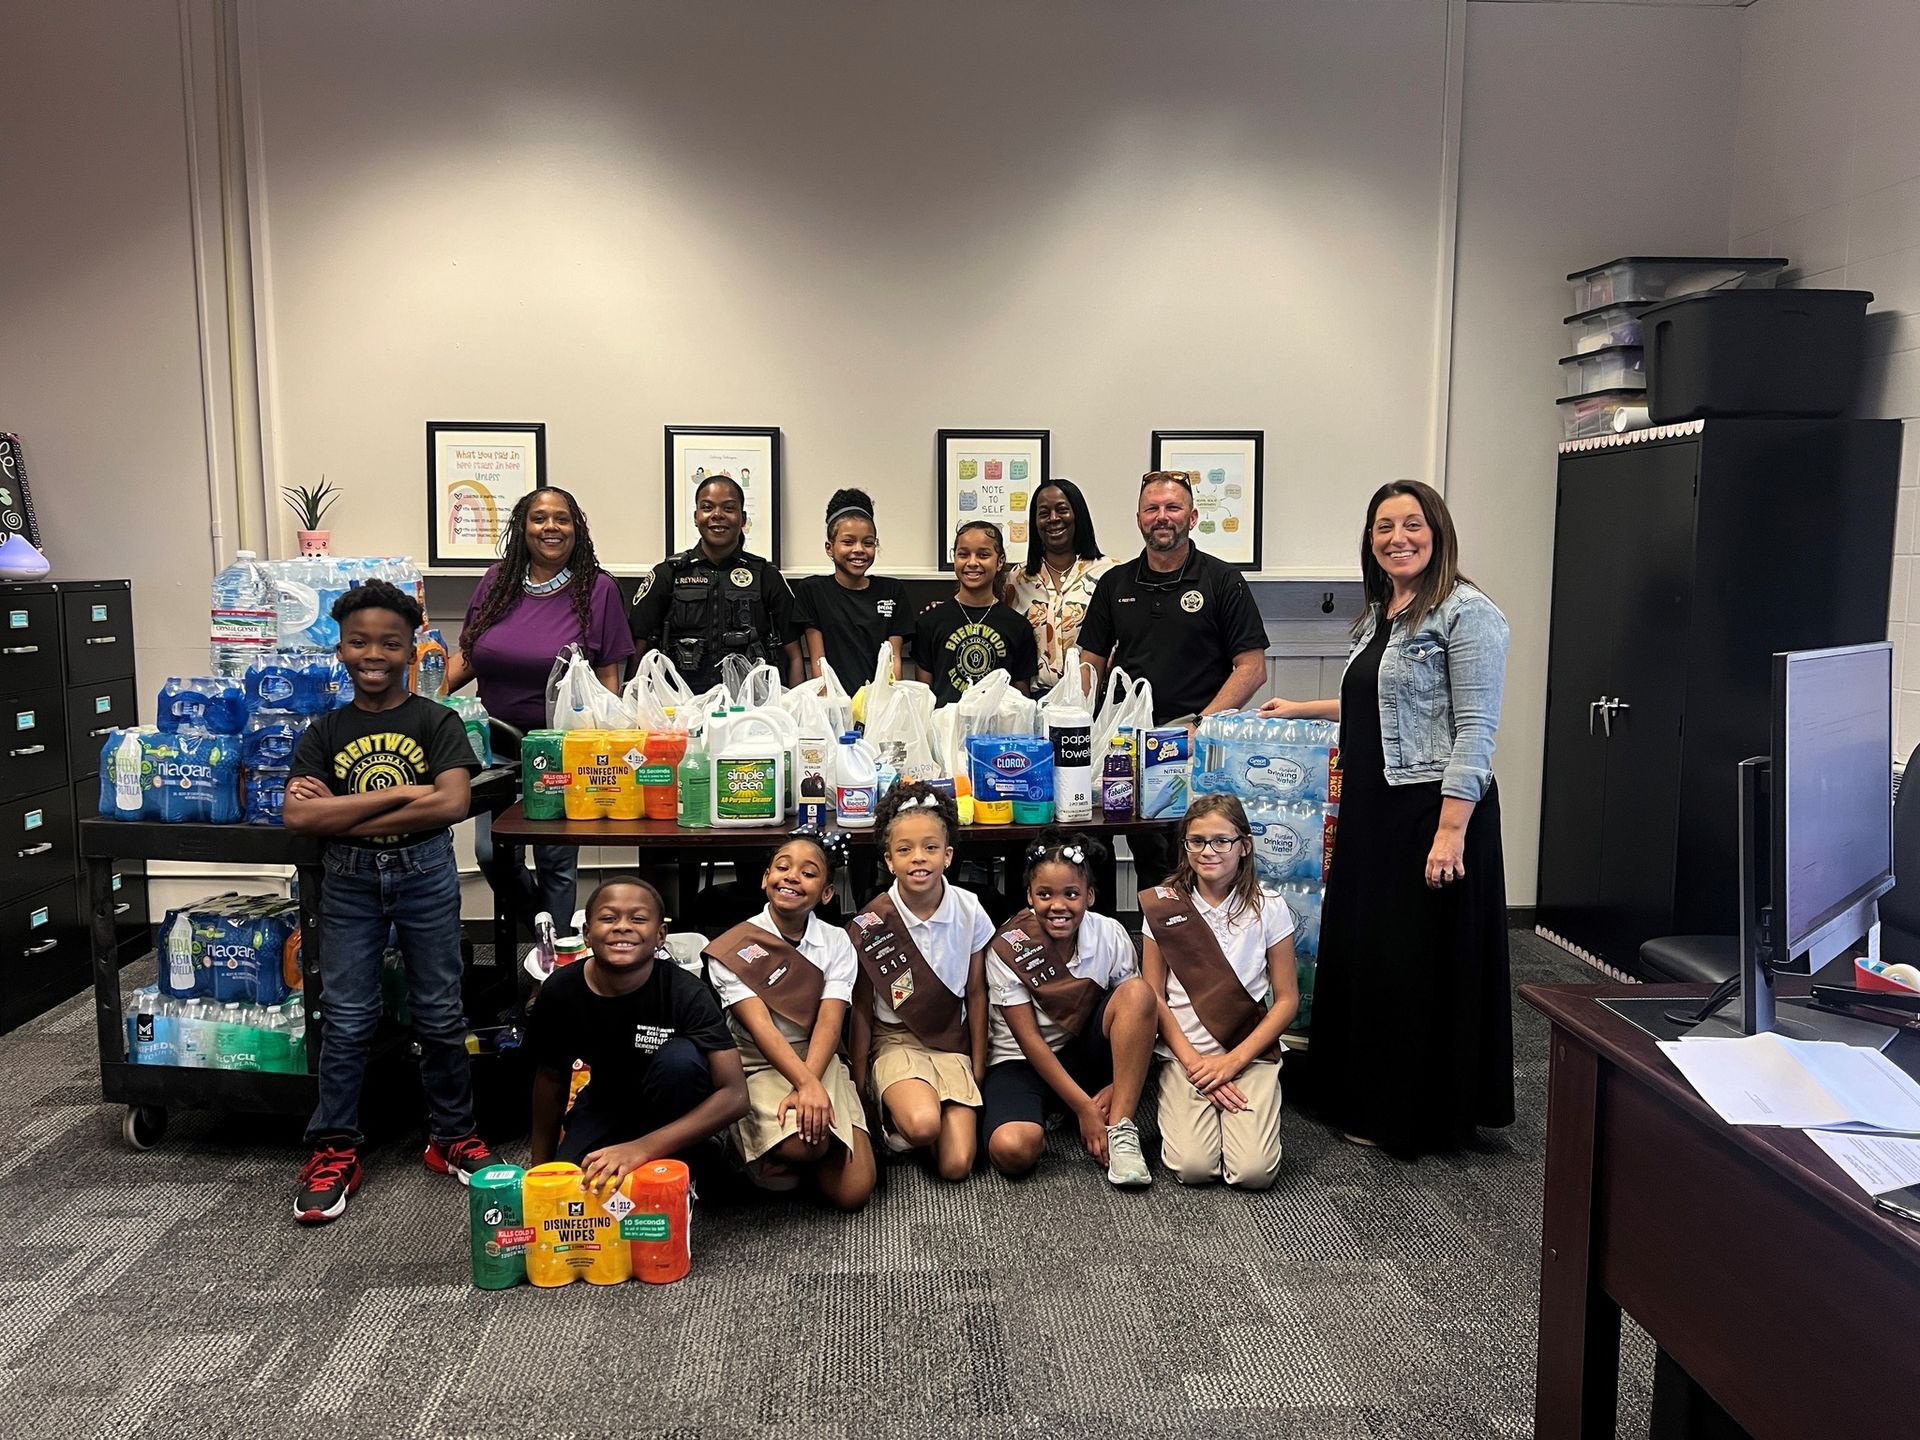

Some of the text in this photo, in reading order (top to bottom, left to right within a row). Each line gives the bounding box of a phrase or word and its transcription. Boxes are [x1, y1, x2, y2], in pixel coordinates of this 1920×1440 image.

[456, 450, 476, 460] What
[478, 451, 492, 460] you
[982, 486, 1004, 494] NOTE
[988, 496, 998, 504] TO
[982, 505, 1005, 514] SELF
[944, 623, 1006, 658] BRENTWOOD
[1062, 735, 1090, 746] pape
[1158, 741, 1178, 761] Soft Scrub
[354, 754, 407, 774] NATIONAL
[996, 758, 1026, 768] CLOROX
[158, 762, 212, 779] niagara
[578, 766, 628, 776] DISINFECTING
[727, 769, 764, 782] simple
[1268, 769, 1298, 780] Drinking
[589, 776, 617, 785] WIPES
[728, 782, 764, 793] green
[1108, 784, 1133, 798] Fabuloso
[1264, 838, 1293, 847] Drinking
[1324, 847, 1333, 870] PACK
[207, 944, 256, 960] niagara
[544, 1216, 611, 1231] DISINFECTING
[558, 1229, 595, 1242] WIPES
